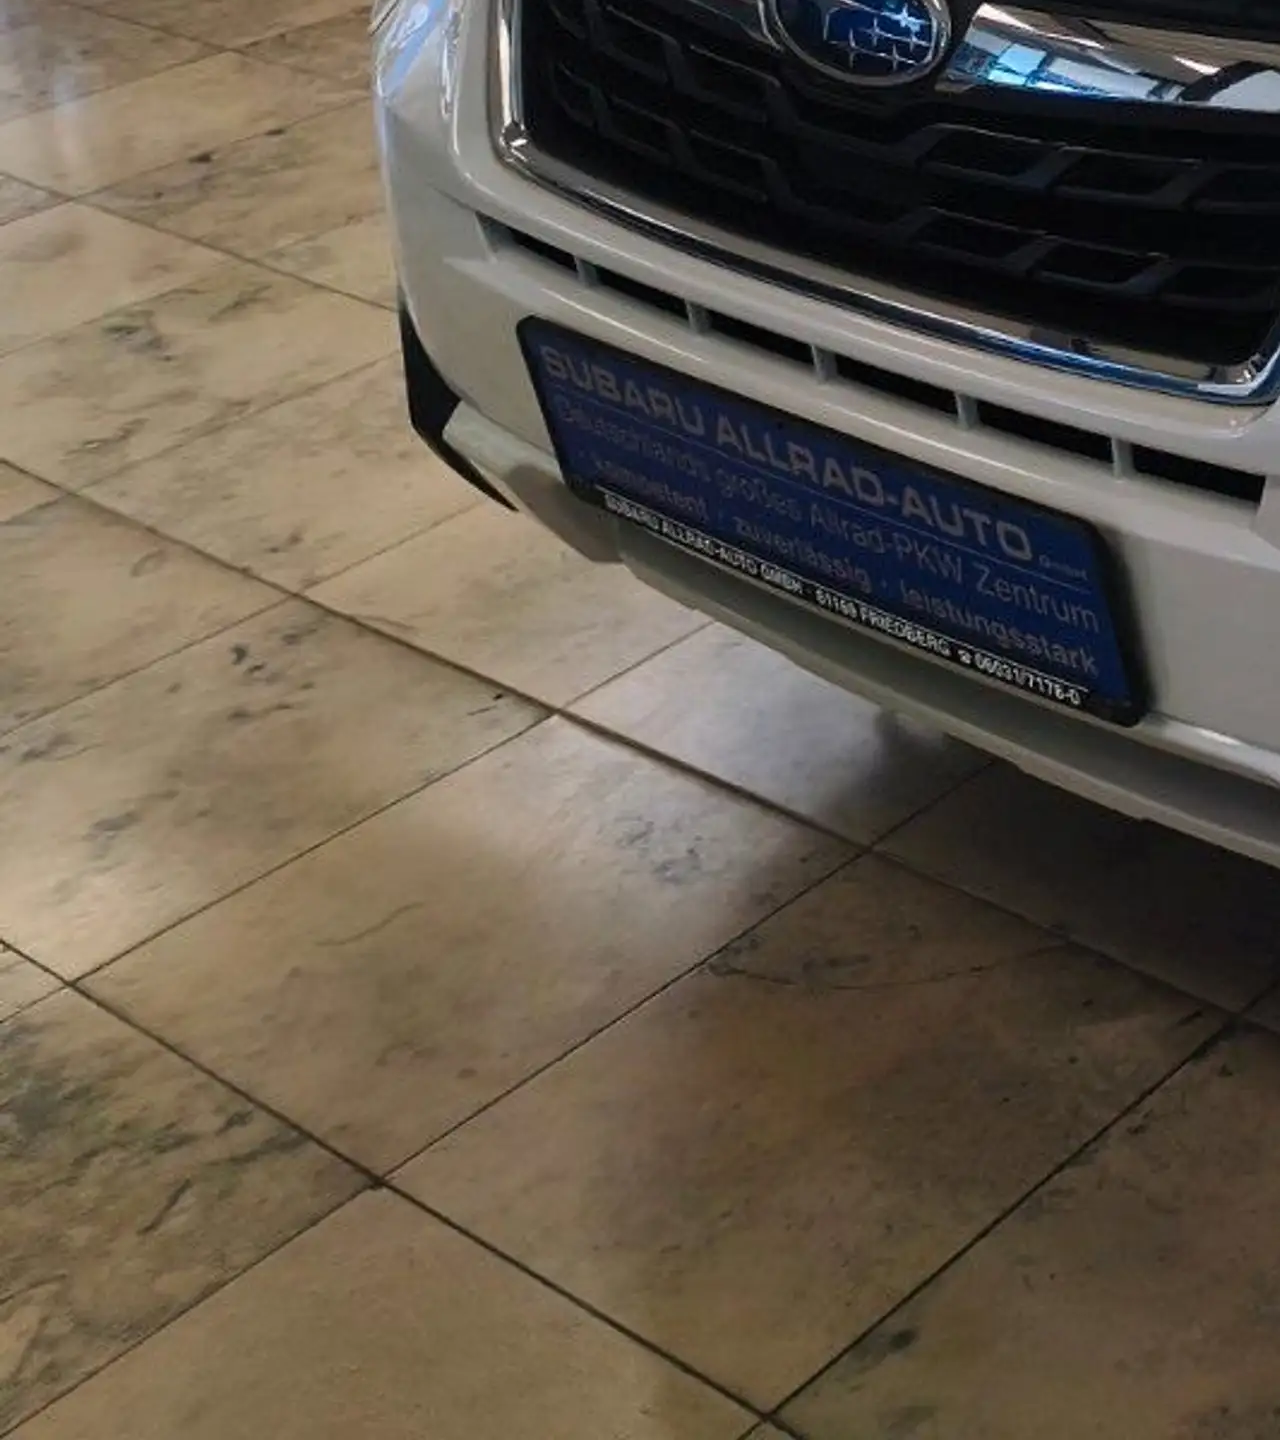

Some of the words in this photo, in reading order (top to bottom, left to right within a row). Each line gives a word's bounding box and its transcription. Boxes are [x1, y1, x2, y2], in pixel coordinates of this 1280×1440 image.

[540, 345, 706, 436] SUBARU
[716, 413, 1033, 561] ALLRAD-AUTO
[810, 502, 963, 585] Allrad-PKW
[972, 561, 1099, 634] Zentrum
[901, 578, 1099, 679] leistungsstark
